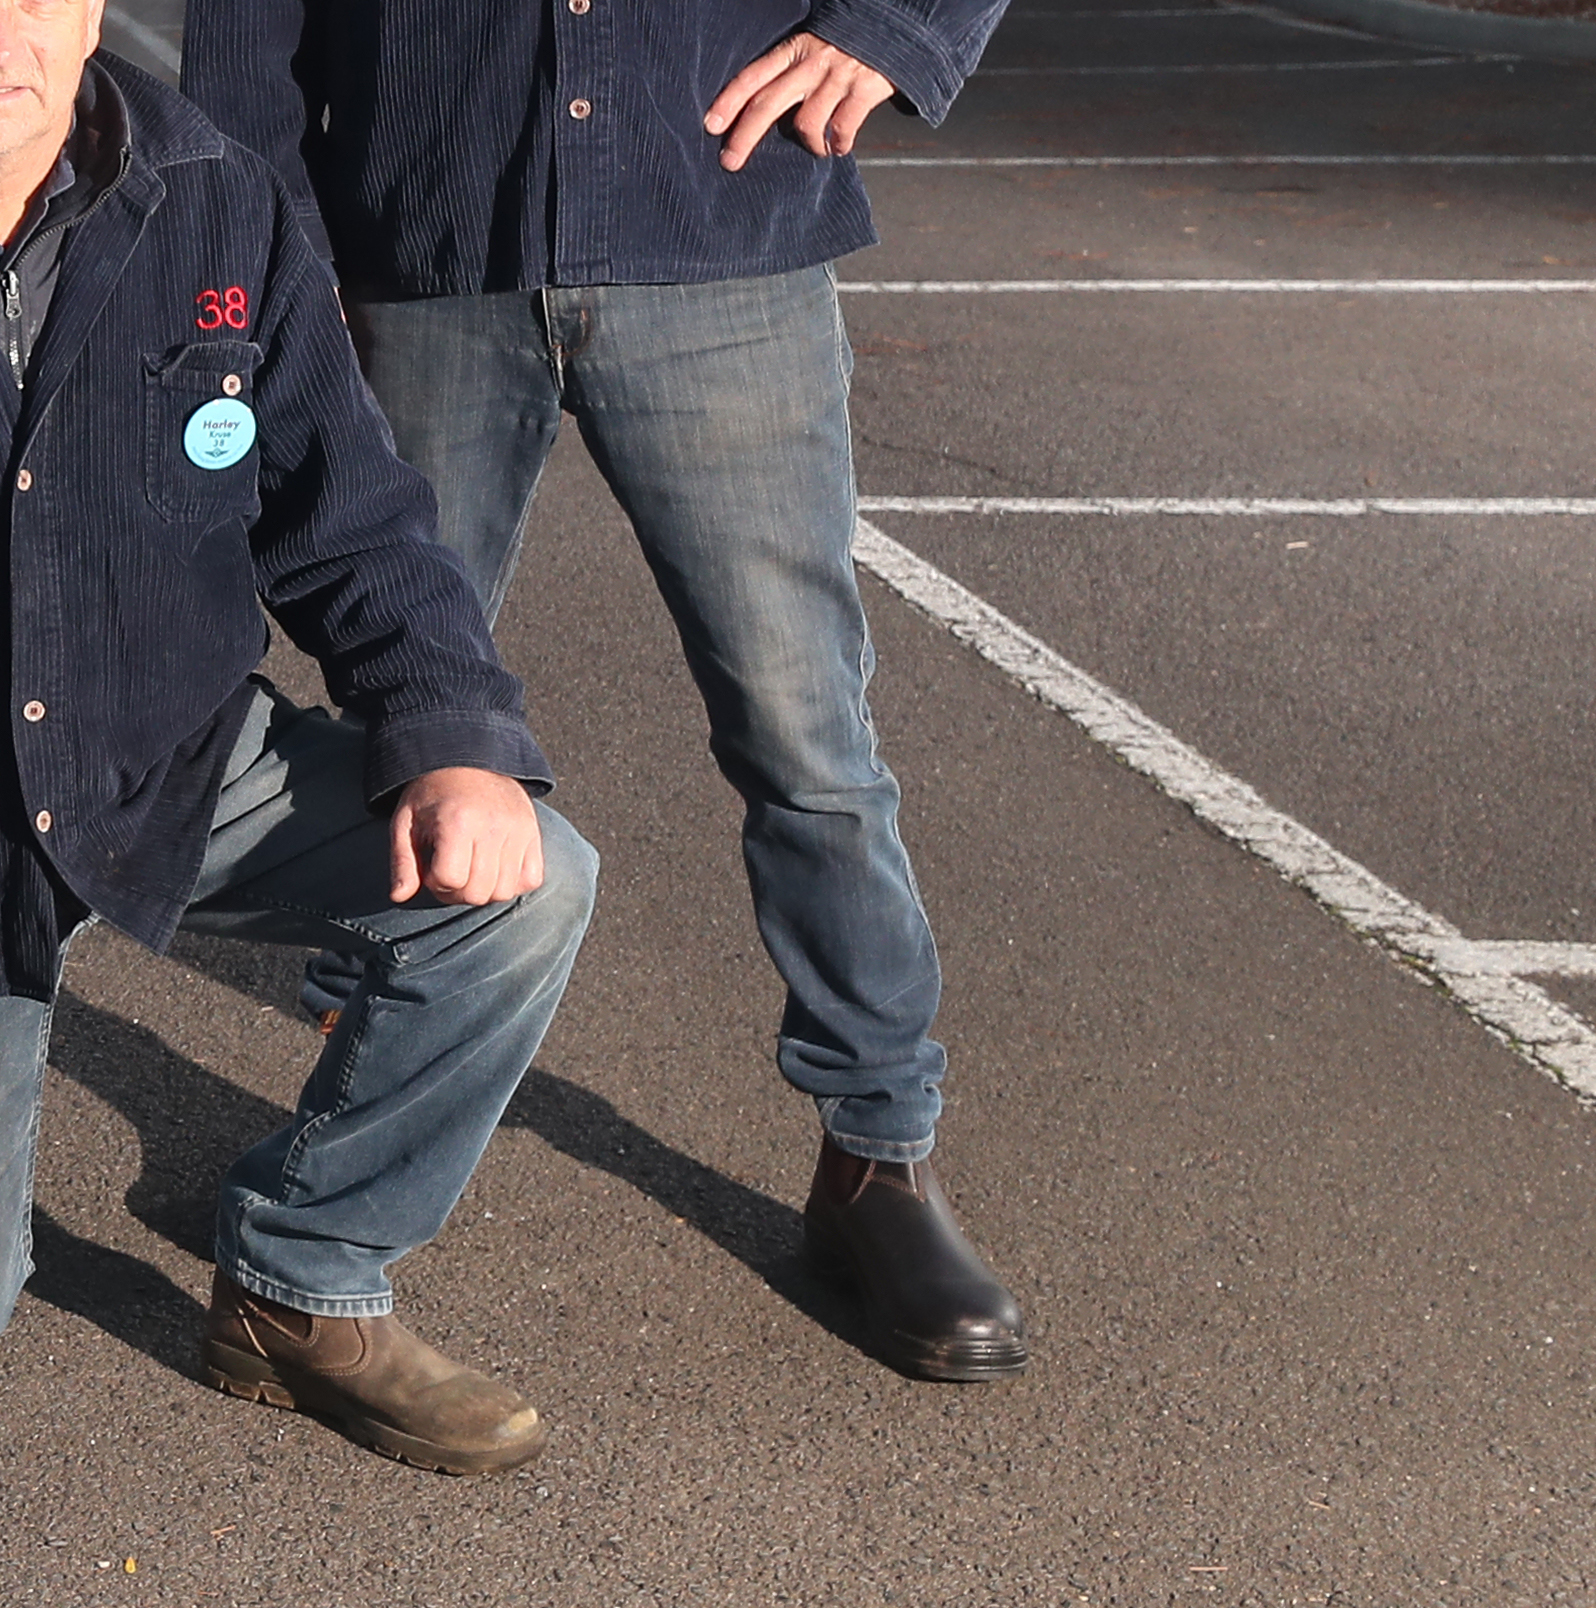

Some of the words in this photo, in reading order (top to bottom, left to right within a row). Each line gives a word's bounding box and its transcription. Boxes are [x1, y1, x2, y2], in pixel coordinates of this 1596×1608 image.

[195, 285, 249, 330] 38
[203, 418, 241, 431] Harley
[213, 439, 225, 447] 38
